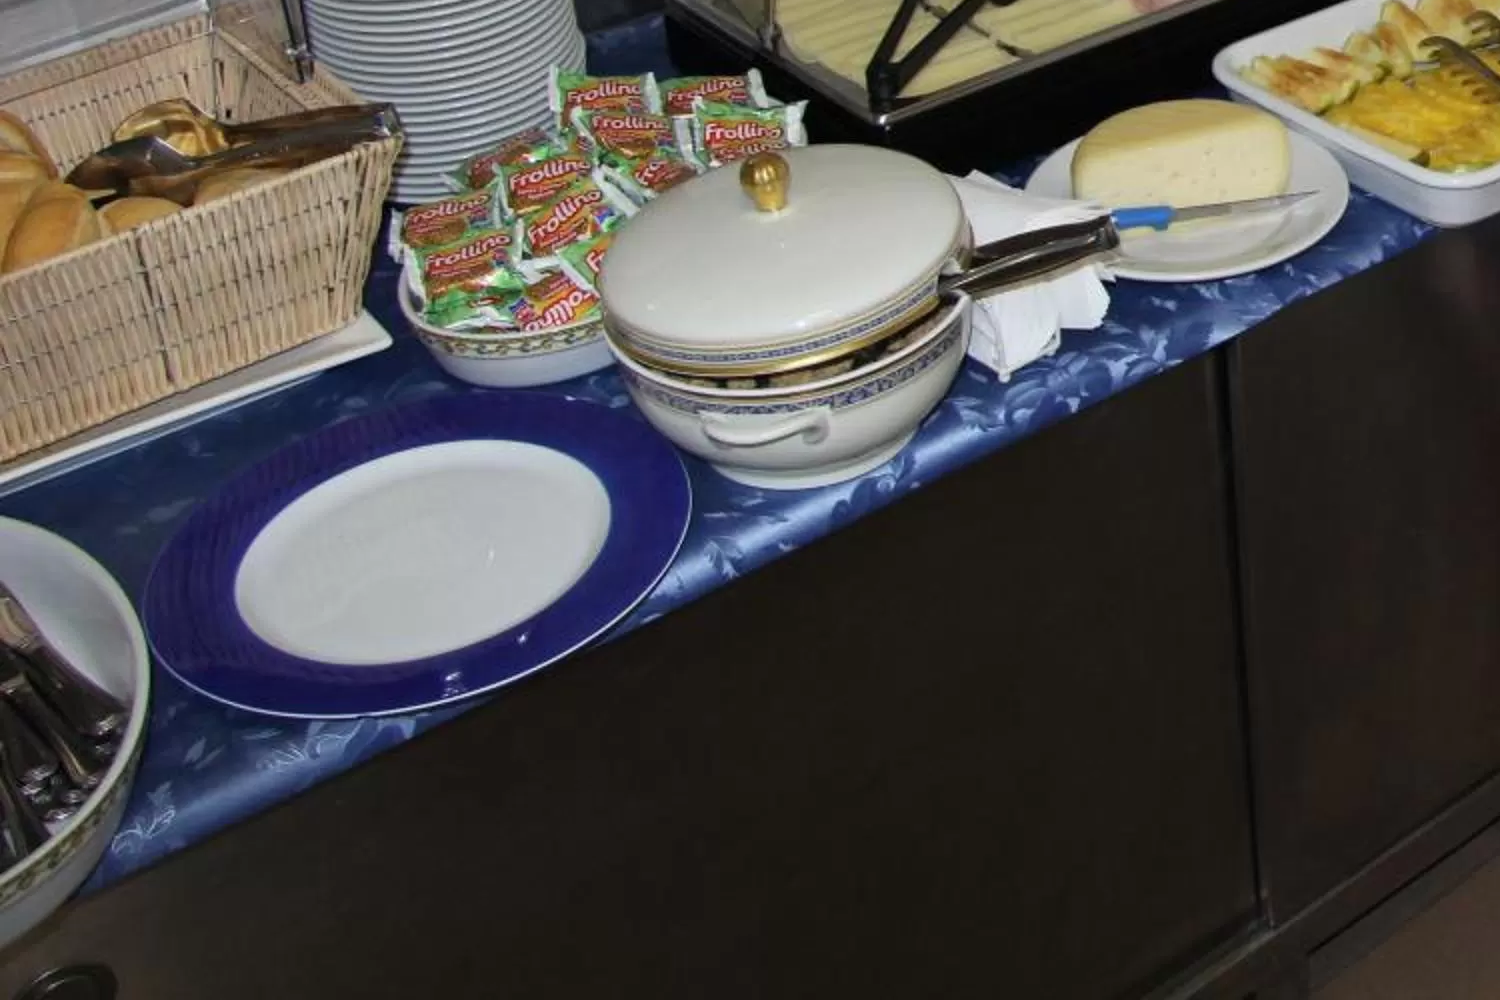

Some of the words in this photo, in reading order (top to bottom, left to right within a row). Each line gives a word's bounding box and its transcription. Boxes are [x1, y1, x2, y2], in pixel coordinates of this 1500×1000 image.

[667, 77, 745, 102] Frollino
[705, 119, 782, 141] Frollino
[509, 160, 591, 190] Frollino
[405, 193, 489, 227] Frollino
[528, 189, 601, 244] Frollino
[425, 233, 512, 272] Frollino
